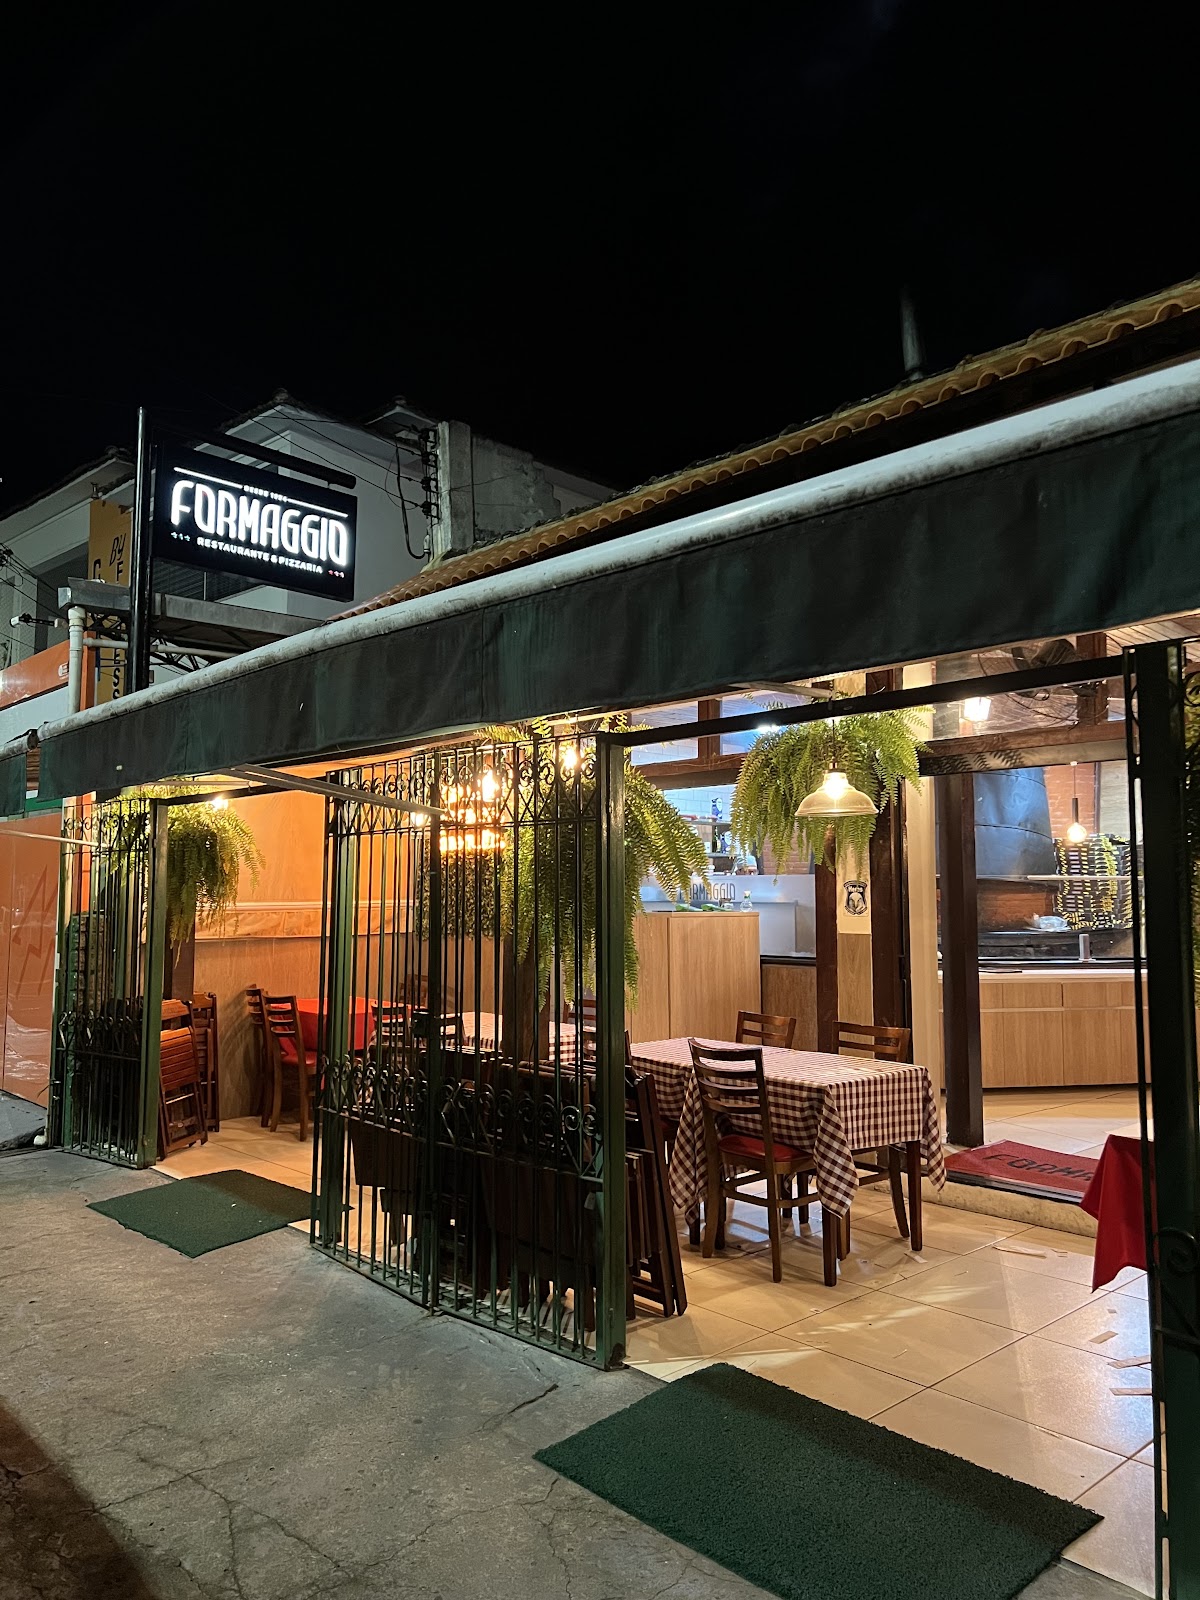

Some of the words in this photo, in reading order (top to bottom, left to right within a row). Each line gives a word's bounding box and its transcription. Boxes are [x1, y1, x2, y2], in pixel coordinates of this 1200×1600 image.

[171, 480, 348, 566] FORMAGGIO
[197, 537, 269, 561] RESTAURANTE
[271, 555, 278, 563] &
[279, 556, 323, 573] PIZZARIA
